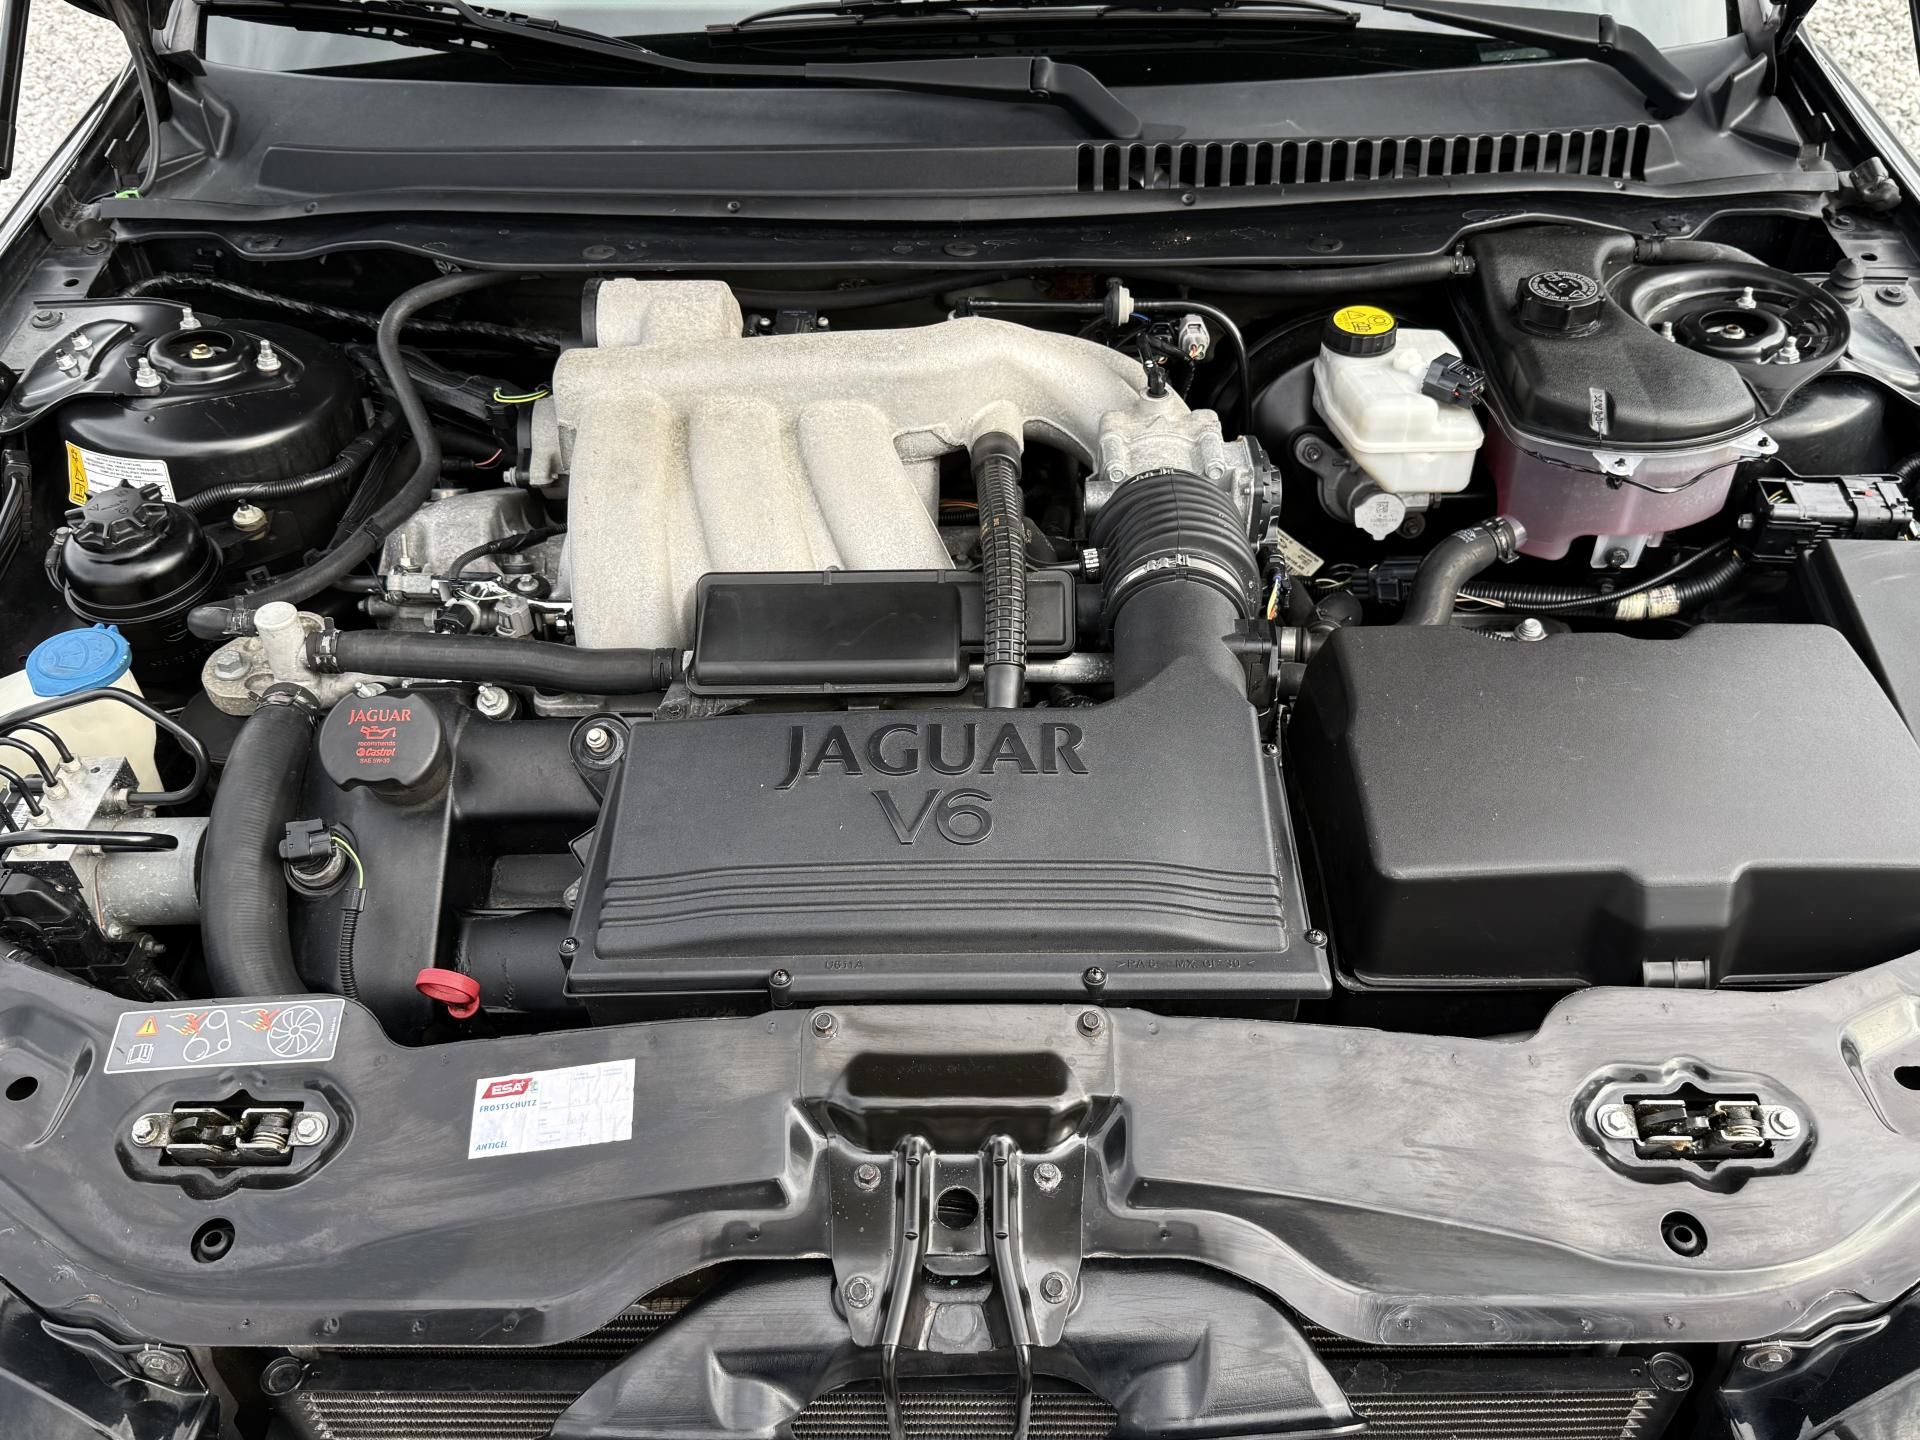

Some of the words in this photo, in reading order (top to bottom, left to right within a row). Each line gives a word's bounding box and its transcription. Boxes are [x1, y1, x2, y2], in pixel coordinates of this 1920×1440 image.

[347, 709, 412, 725] JAGUAR
[365, 747, 396, 757] Castrol
[774, 722, 1089, 790] JAGUAR
[870, 787, 994, 846] V6
[479, 1099, 537, 1113] FROSTSCHUTZ
[475, 1140, 508, 1152] ANTIGEL
